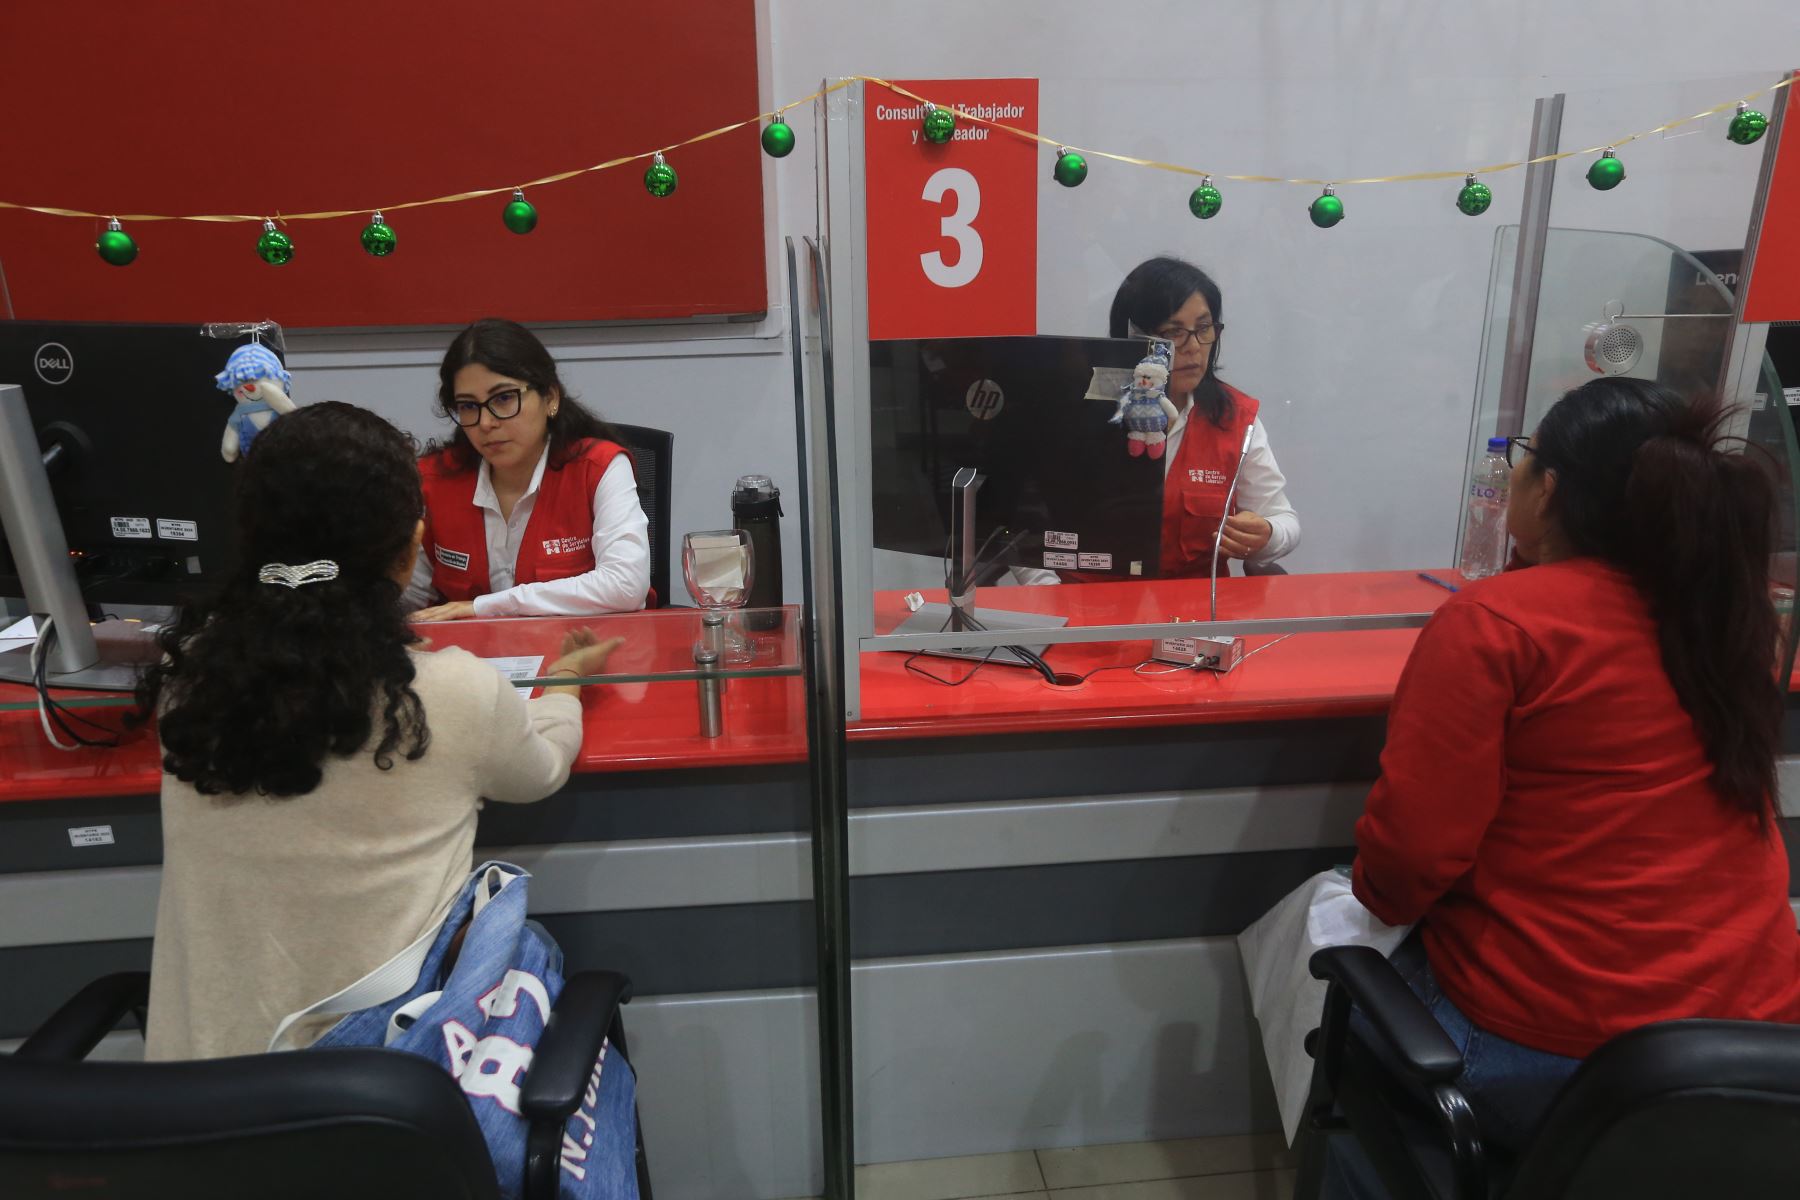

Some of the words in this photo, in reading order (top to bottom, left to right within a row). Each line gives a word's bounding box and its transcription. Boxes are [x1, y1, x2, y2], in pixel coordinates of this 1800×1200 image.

[958, 102, 1025, 122] Trabajador
[911, 129, 919, 144] y
[919, 167, 984, 288] 3
[40, 358, 70, 369] DELL
